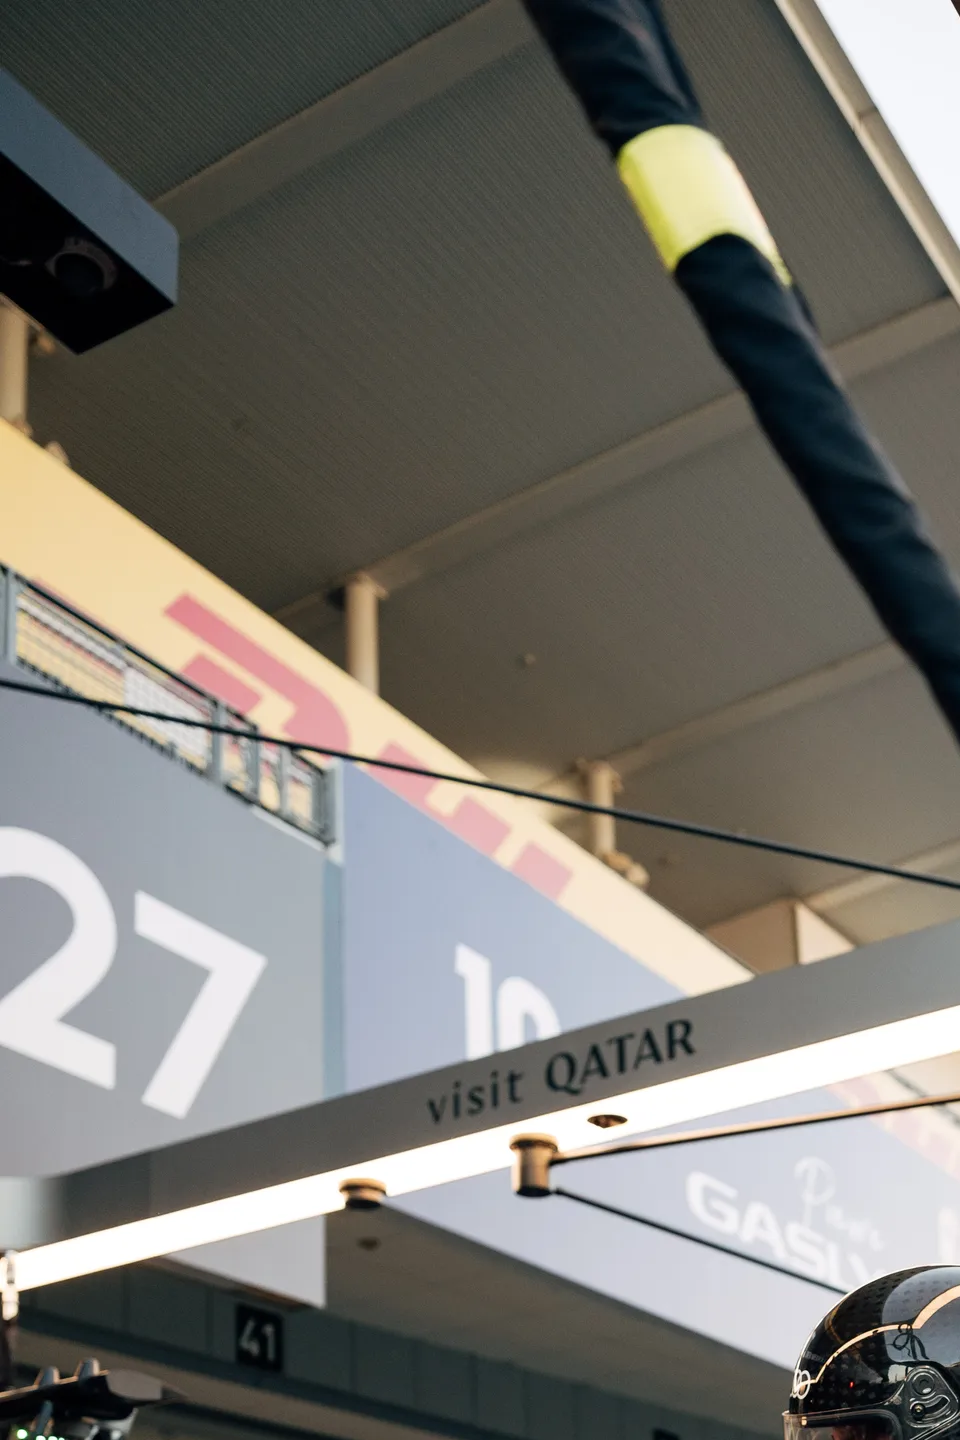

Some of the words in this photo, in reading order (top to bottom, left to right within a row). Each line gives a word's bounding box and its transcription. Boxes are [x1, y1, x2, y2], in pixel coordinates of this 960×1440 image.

[0, 826, 267, 1119] 27
[427, 1069, 524, 1124] visit
[545, 1018, 697, 1096] QATAR
[240, 1318, 276, 1362] 41
